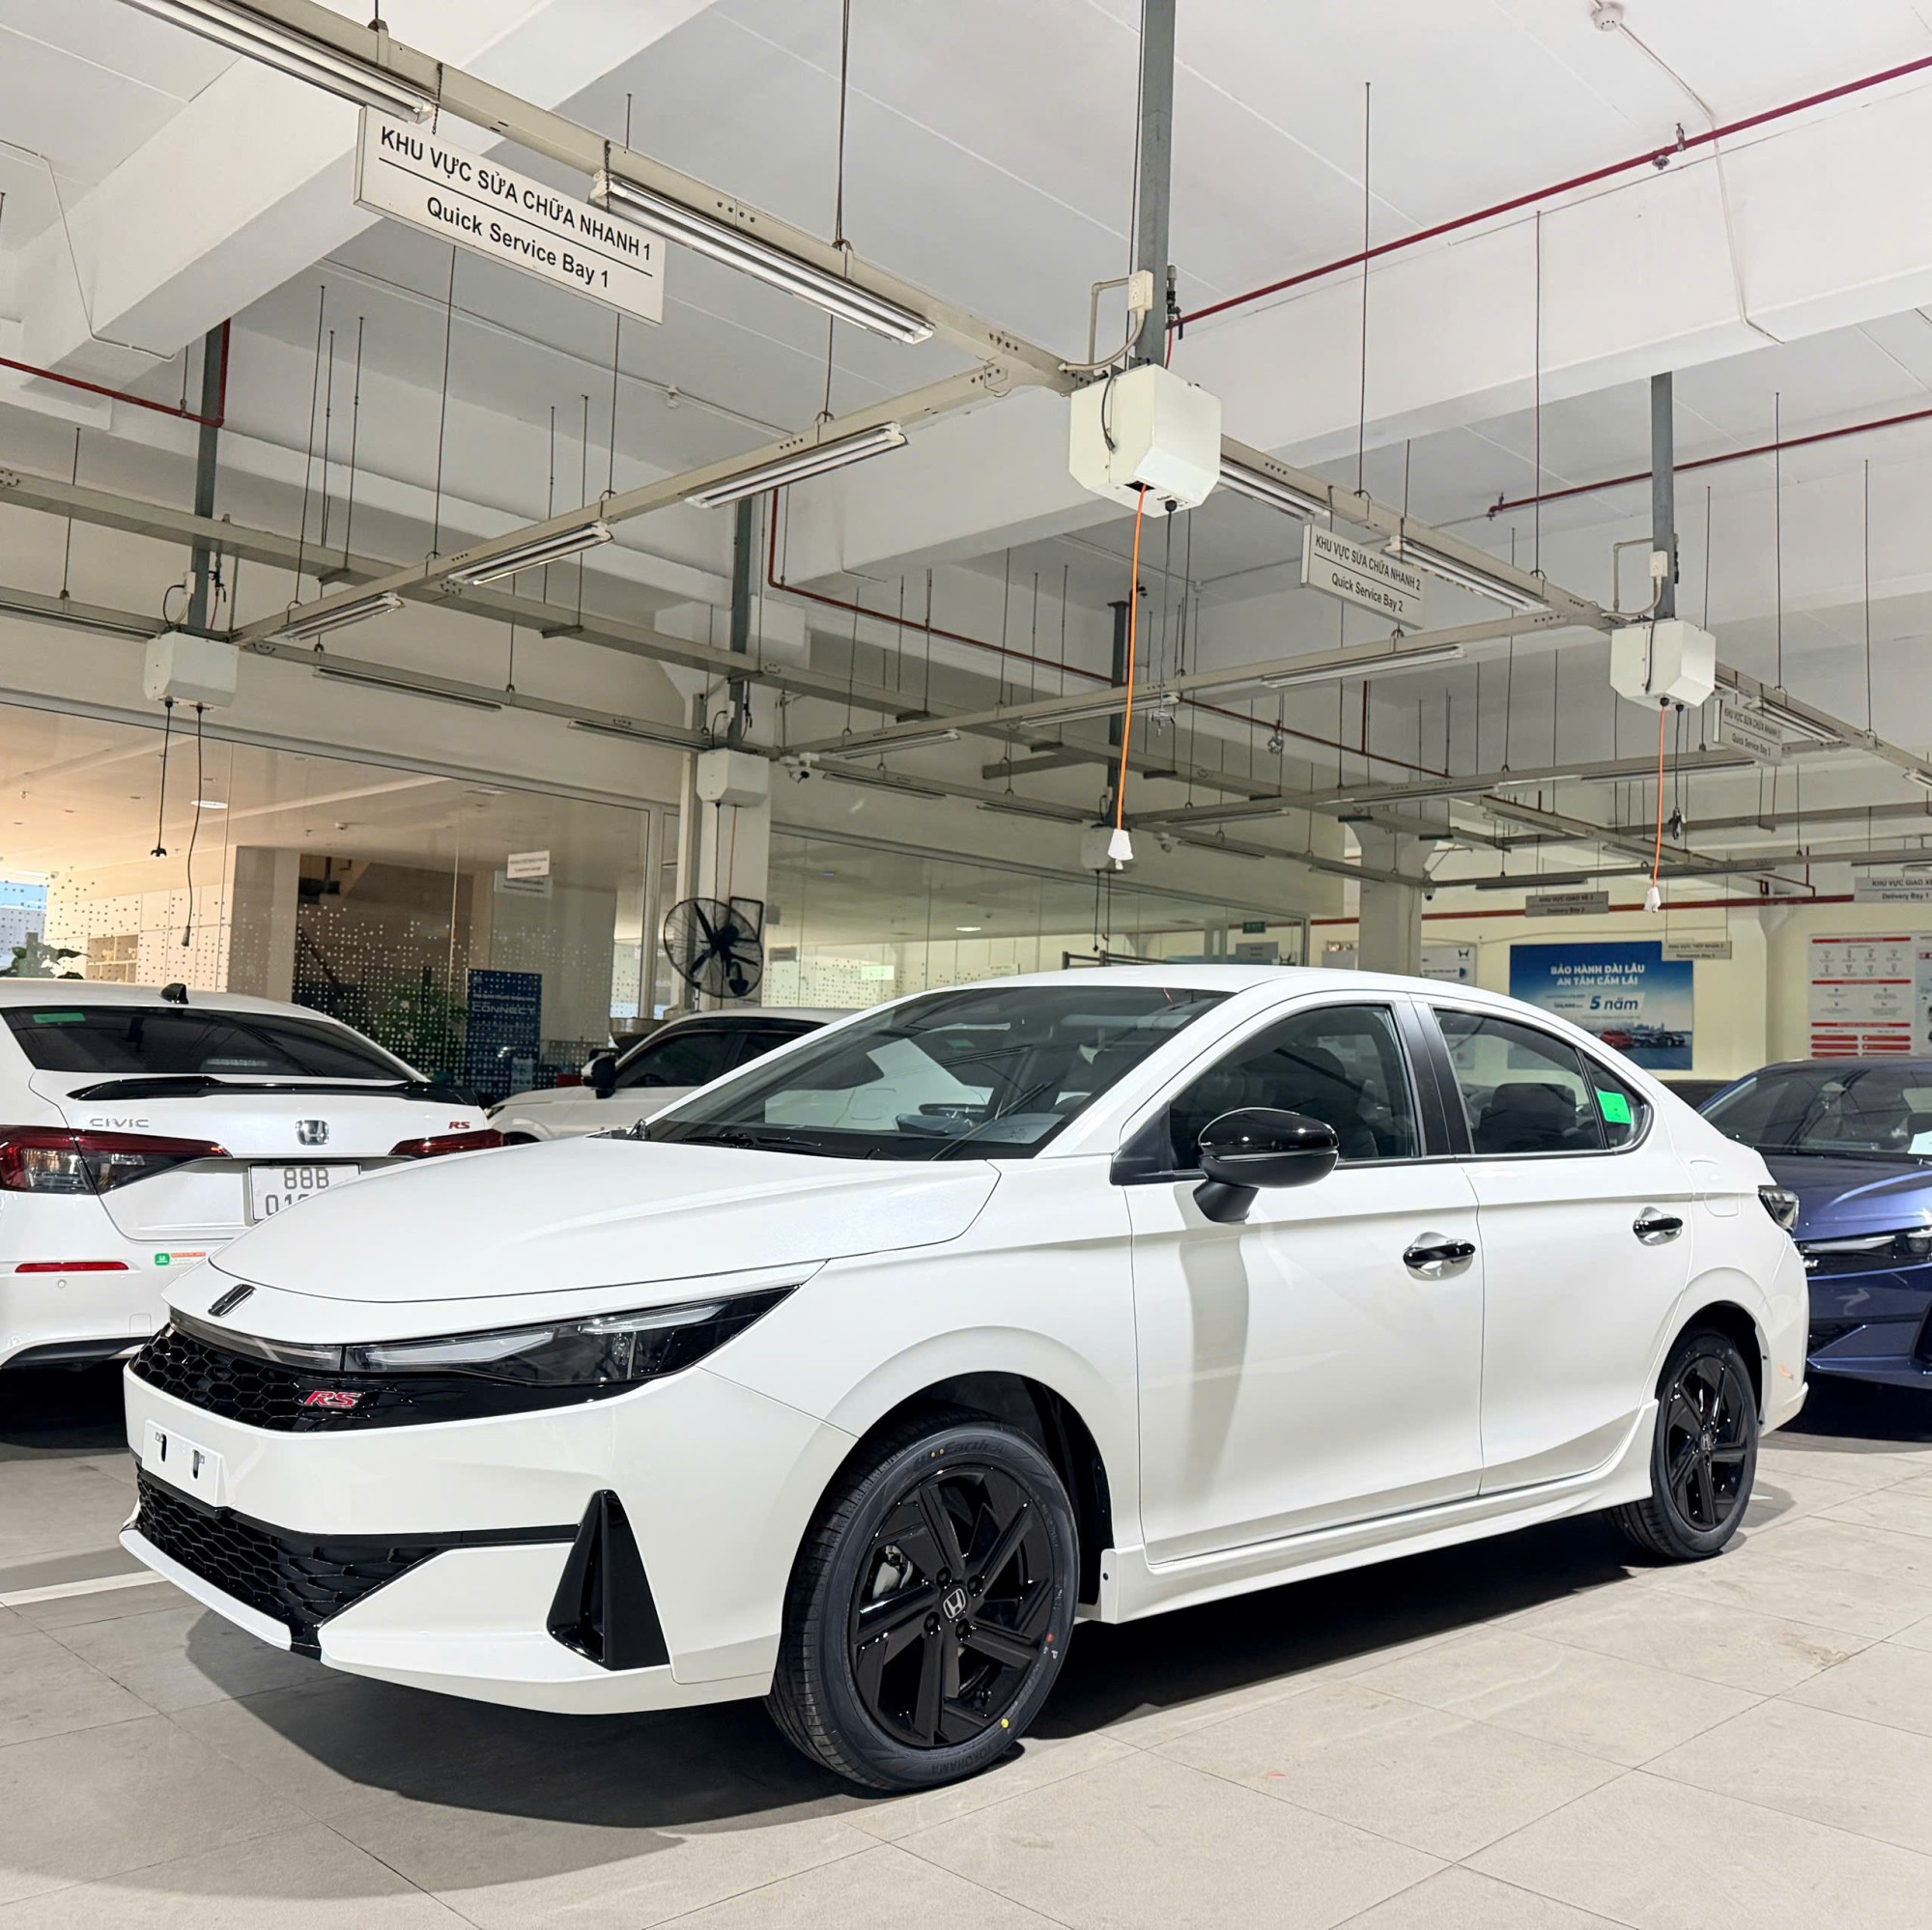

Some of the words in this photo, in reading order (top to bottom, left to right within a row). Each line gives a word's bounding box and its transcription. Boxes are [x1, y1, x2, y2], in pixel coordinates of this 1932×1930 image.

[382, 126, 423, 160] KHU
[430, 147, 471, 182] VỰC
[477, 170, 518, 203] SỬA
[523, 190, 575, 228] CHỮA
[580, 214, 639, 256] NHANH
[643, 242, 650, 260] 1
[427, 196, 483, 236] Quick
[489, 222, 556, 266] Service
[562, 252, 595, 285] Bay
[600, 270, 609, 288] 1
[1315, 534, 1332, 553] KHU
[1333, 542, 1350, 561] VỰC
[1390, 567, 1415, 588] NHANH
[1415, 579, 1421, 591] 2
[1331, 573, 1353, 591] Quick
[1355, 582, 1381, 604] Service
[1383, 593, 1397, 612] Bay
[1398, 600, 1404, 611] 2
[1911, 892, 1923, 900] Bay
[1574, 963, 1603, 975] HÀNH
[1605, 962, 1623, 974] DÀI
[1556, 977, 1571, 986] AN
[471, 1005, 536, 1015] CONNECT
[1589, 995, 1602, 1010] 5
[1604, 996, 1638, 1010] năm
[89, 1118, 150, 1128] CIVIC
[448, 1121, 470, 1129] RS
[283, 1167, 329, 1189] 88B
[303, 1390, 362, 1408] RS
